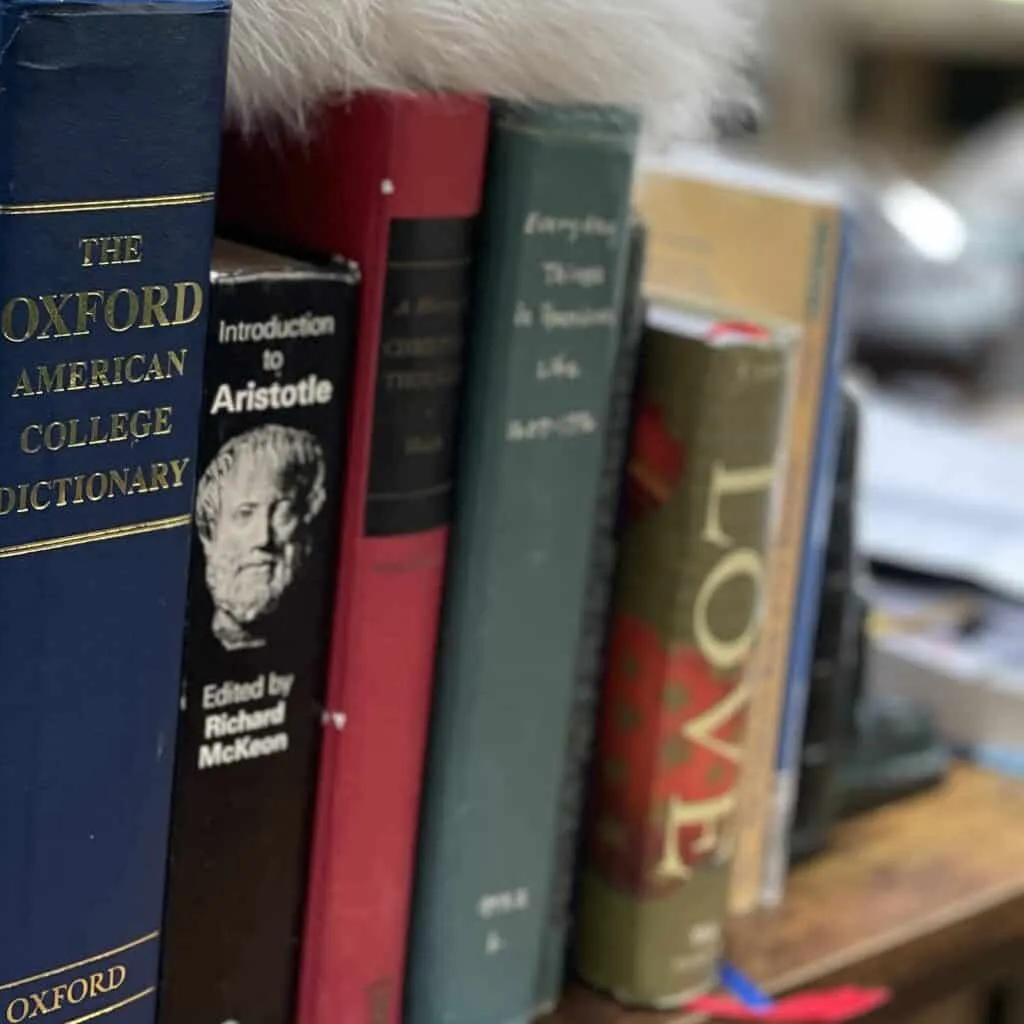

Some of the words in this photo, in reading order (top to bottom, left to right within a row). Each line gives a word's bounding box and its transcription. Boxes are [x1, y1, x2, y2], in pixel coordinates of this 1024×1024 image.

[80, 233, 144, 268] THE
[0, 281, 205, 343] OXFORD
[219, 311, 336, 345] Introduction
[11, 348, 189, 398] AMERICAN
[262, 348, 285, 373] to
[209, 374, 335, 416] Aristotle
[20, 406, 173, 455] COLLEGE
[202, 676, 265, 709] Edited
[268, 672, 294, 700] by
[204, 702, 285, 739] Richard
[197, 732, 288, 770] McKeon
[5, 964, 126, 1024] OXFORD
